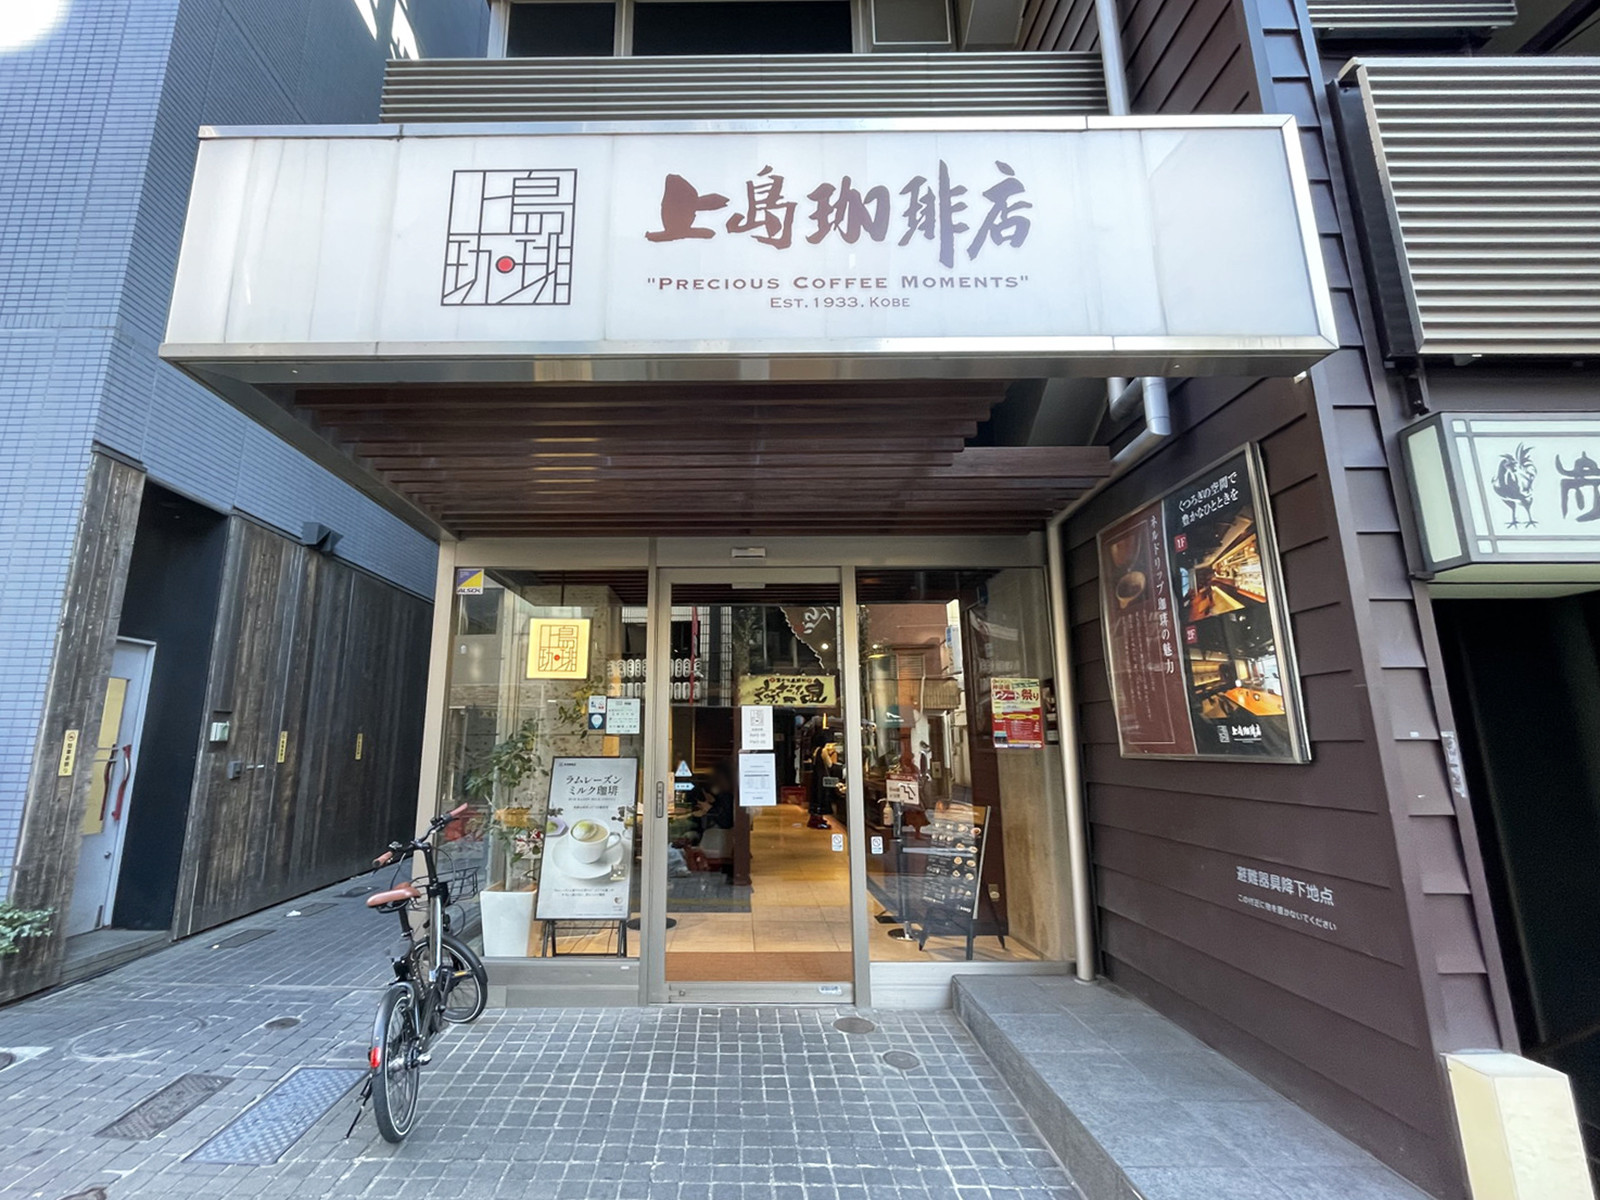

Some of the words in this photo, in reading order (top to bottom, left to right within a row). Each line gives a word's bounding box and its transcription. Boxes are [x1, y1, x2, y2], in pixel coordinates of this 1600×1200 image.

[645, 160, 1033, 268] 上島珈琲店
[1178, 471, 1238, 512] くつろぎの空間で
[1181, 488, 1239, 528] 豊かなひとときを
[1176, 536, 1187, 549] 1F
[1150, 514, 1175, 675] ネルドリップ珈琲の魅力
[566, 774, 622, 785] ラムレーズン
[569, 785, 619, 797] ミルク珈琲
[1236, 865, 1335, 906] 避難器具降下地点
[1237, 894, 1337, 931] この付近に物を置かないでください
